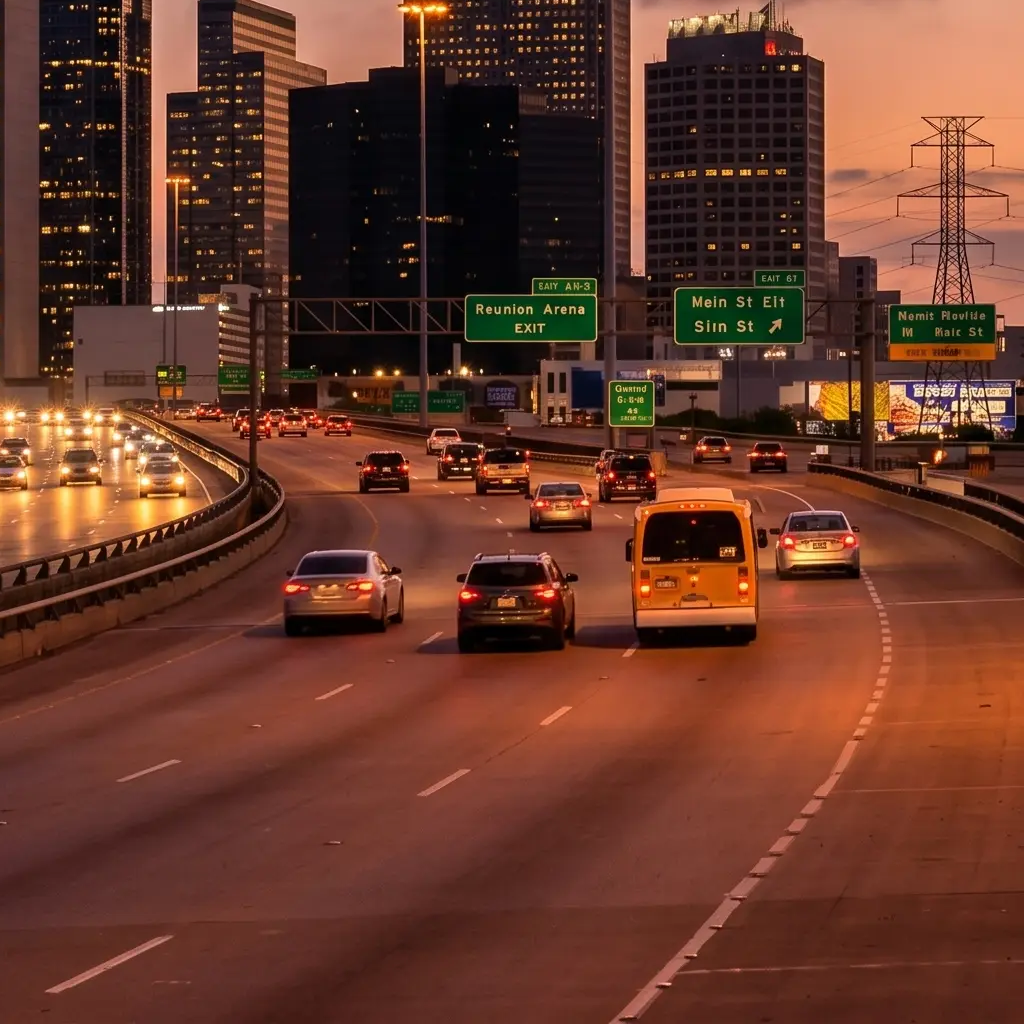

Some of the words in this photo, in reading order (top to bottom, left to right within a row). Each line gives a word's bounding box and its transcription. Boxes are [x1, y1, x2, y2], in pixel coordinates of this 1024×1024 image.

[692, 295, 727, 308] Mein
[736, 295, 753, 308] St
[475, 303, 534, 315] Reunion
[543, 303, 586, 315] Arena
[514, 323, 546, 334] EXIT
[736, 320, 754, 333] St
[968, 327, 983, 337] St
